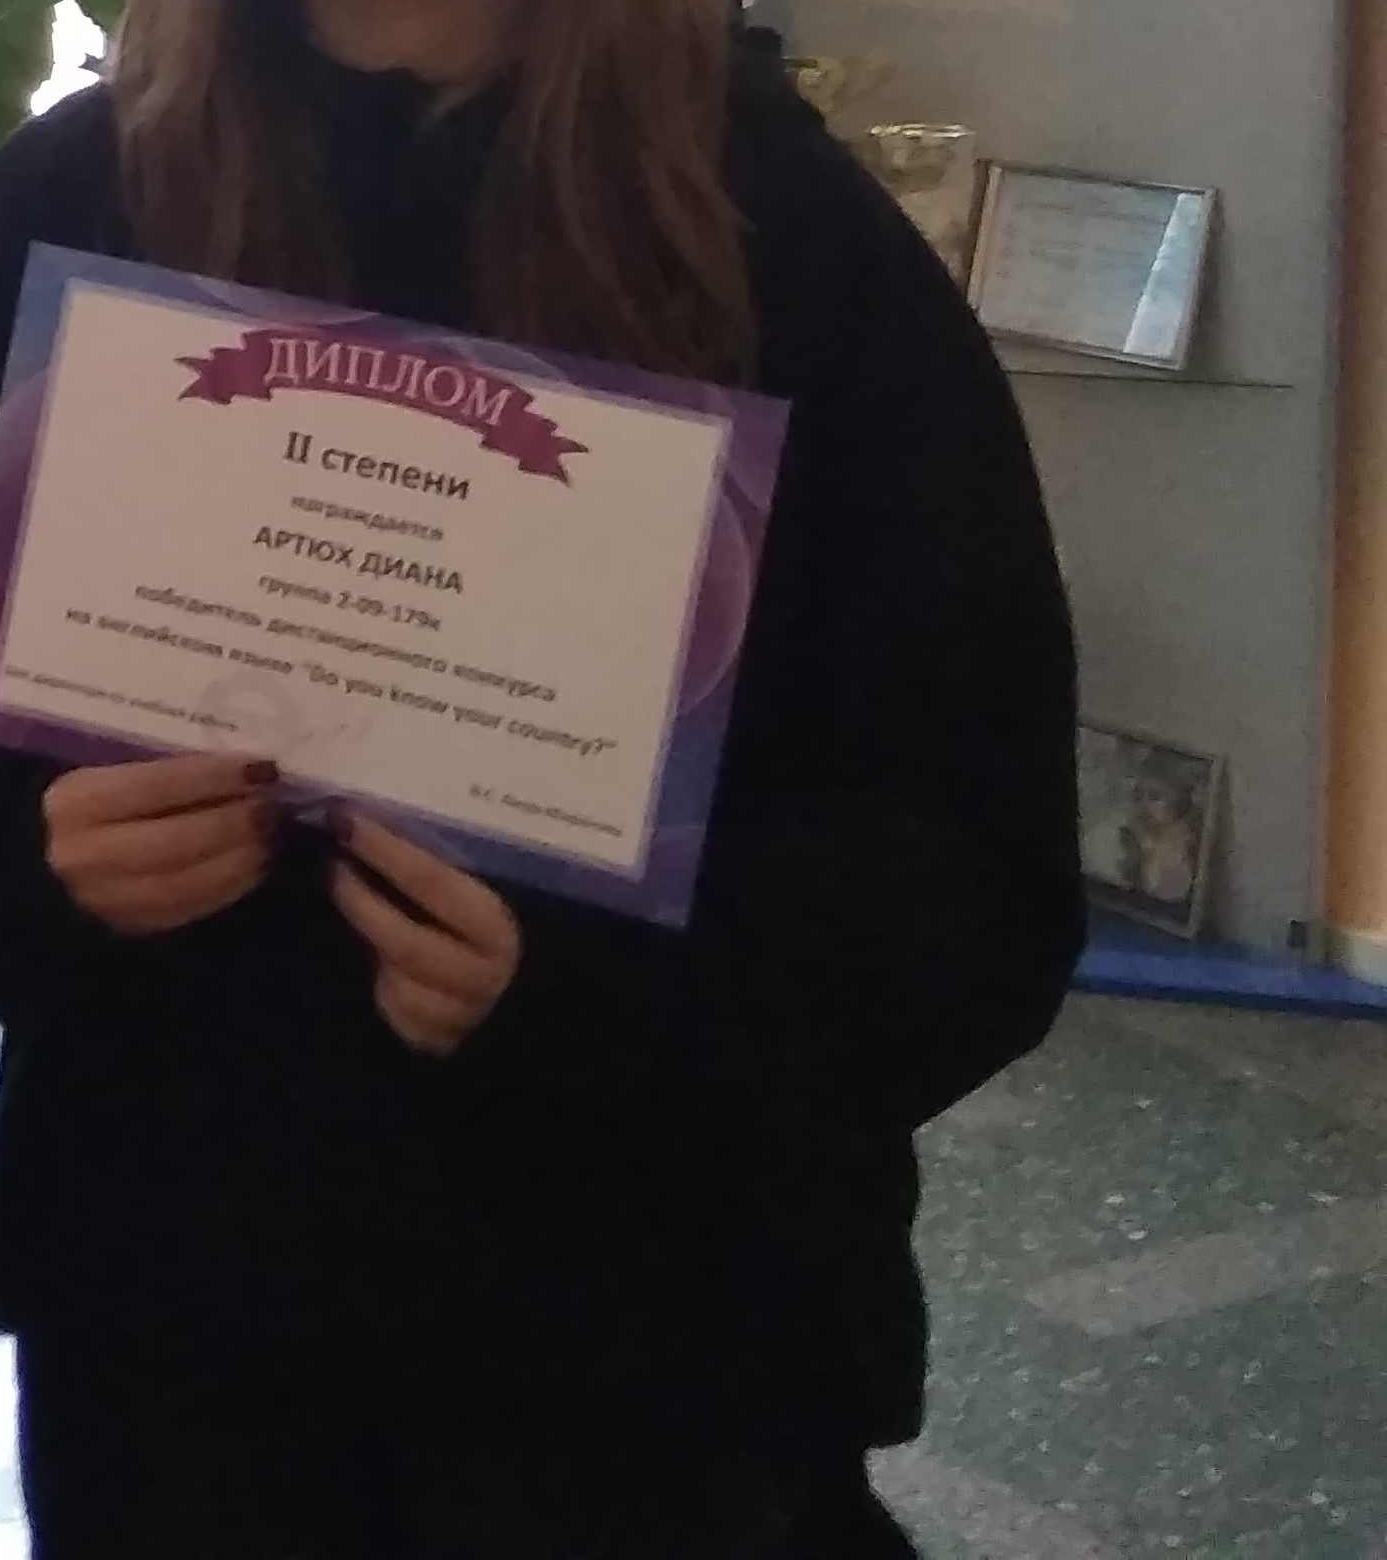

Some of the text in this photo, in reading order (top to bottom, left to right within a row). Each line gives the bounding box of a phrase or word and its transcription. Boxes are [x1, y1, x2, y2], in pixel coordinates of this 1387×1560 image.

[264, 339, 511, 425] ДИПЛОМ
[283, 430, 472, 501] II степени
[252, 525, 464, 594] АРТЮХ ДИАНА
[258, 575, 332, 605] группа
